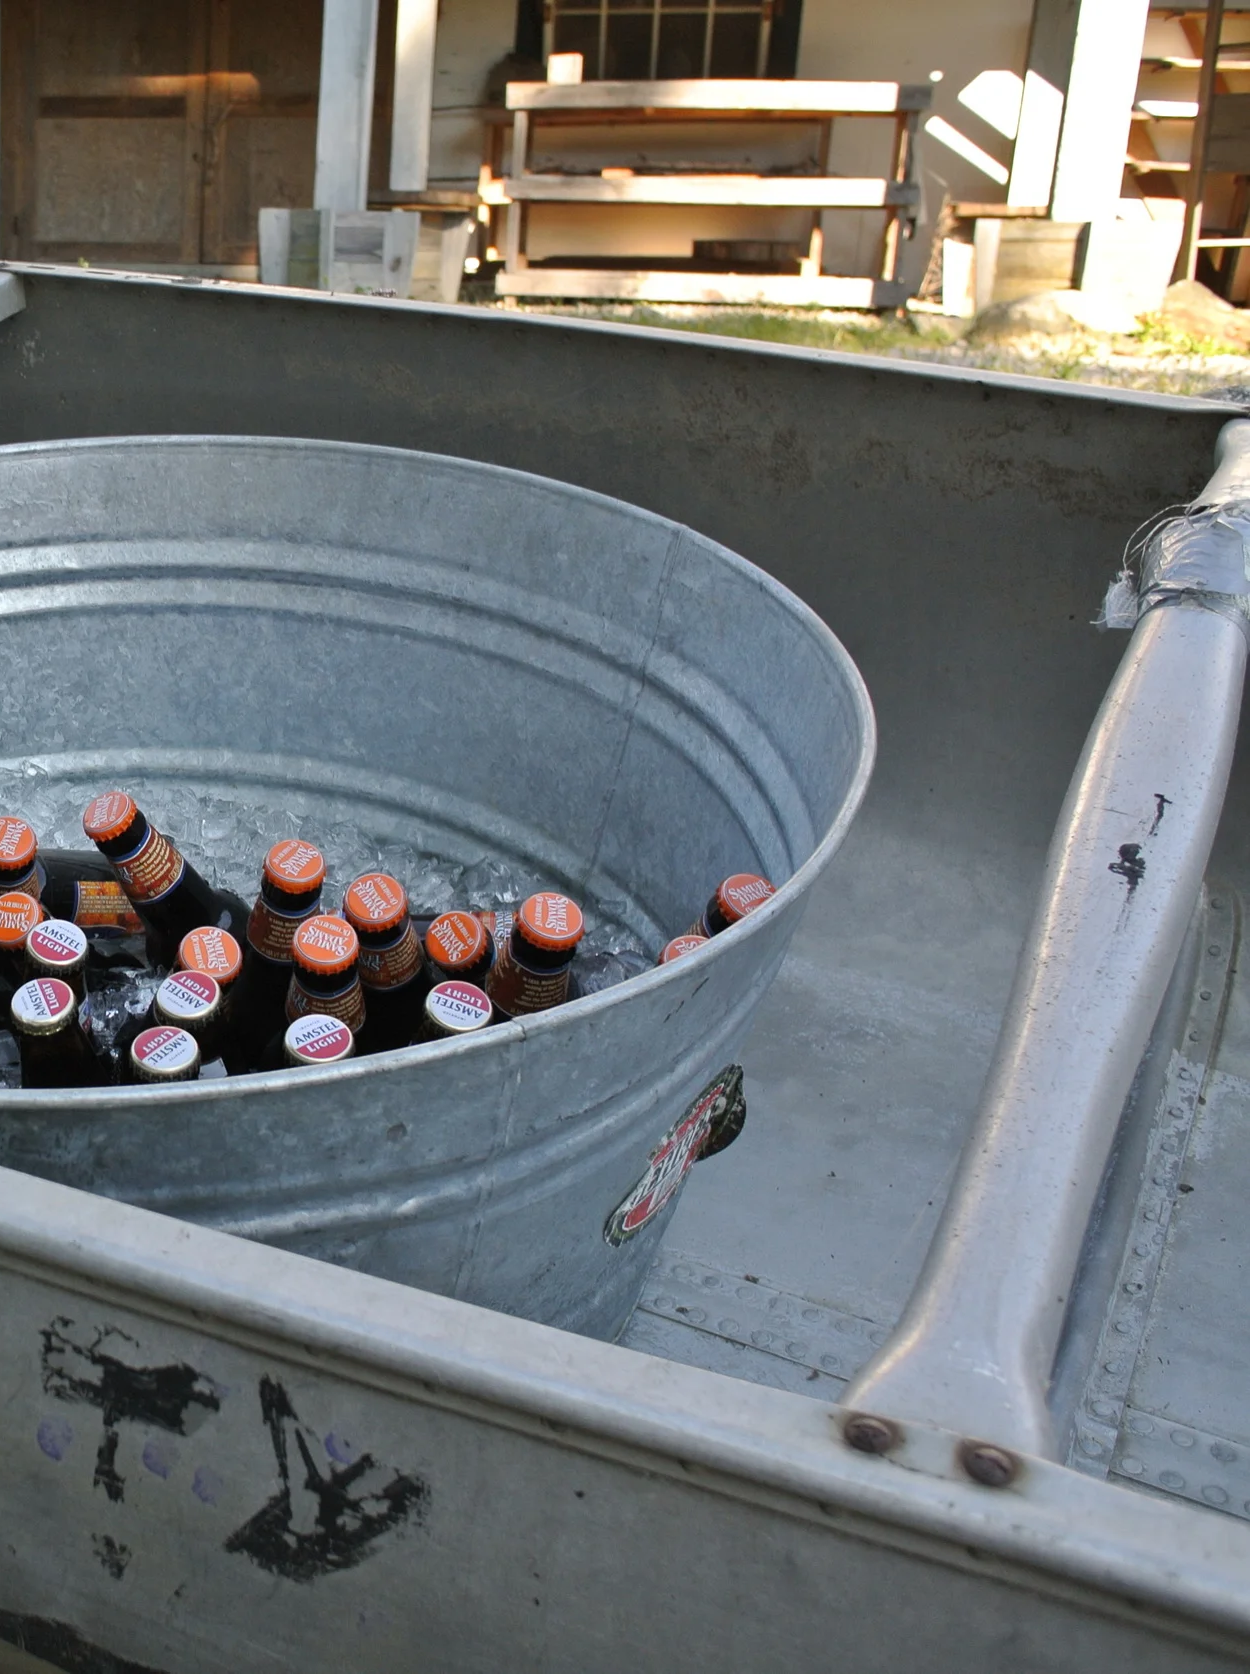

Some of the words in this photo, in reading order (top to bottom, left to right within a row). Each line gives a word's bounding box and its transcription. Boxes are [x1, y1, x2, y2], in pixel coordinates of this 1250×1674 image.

[37, 935, 69, 956] LIGHT
[40, 926, 81, 950] AMSTEL
[26, 983, 47, 1016] AMSTEL
[42, 982, 59, 1009] LIGHT
[164, 982, 204, 1009] AMSTEL
[178, 976, 210, 999] LIGHT
[444, 988, 483, 1008] LIGHT
[434, 995, 483, 1019] AMSTEL
[142, 1030, 174, 1053] LIGHT
[295, 1021, 340, 1045] AMSTEL
[306, 1032, 343, 1053] LIGHT
[148, 1035, 187, 1064] AMSTEL
